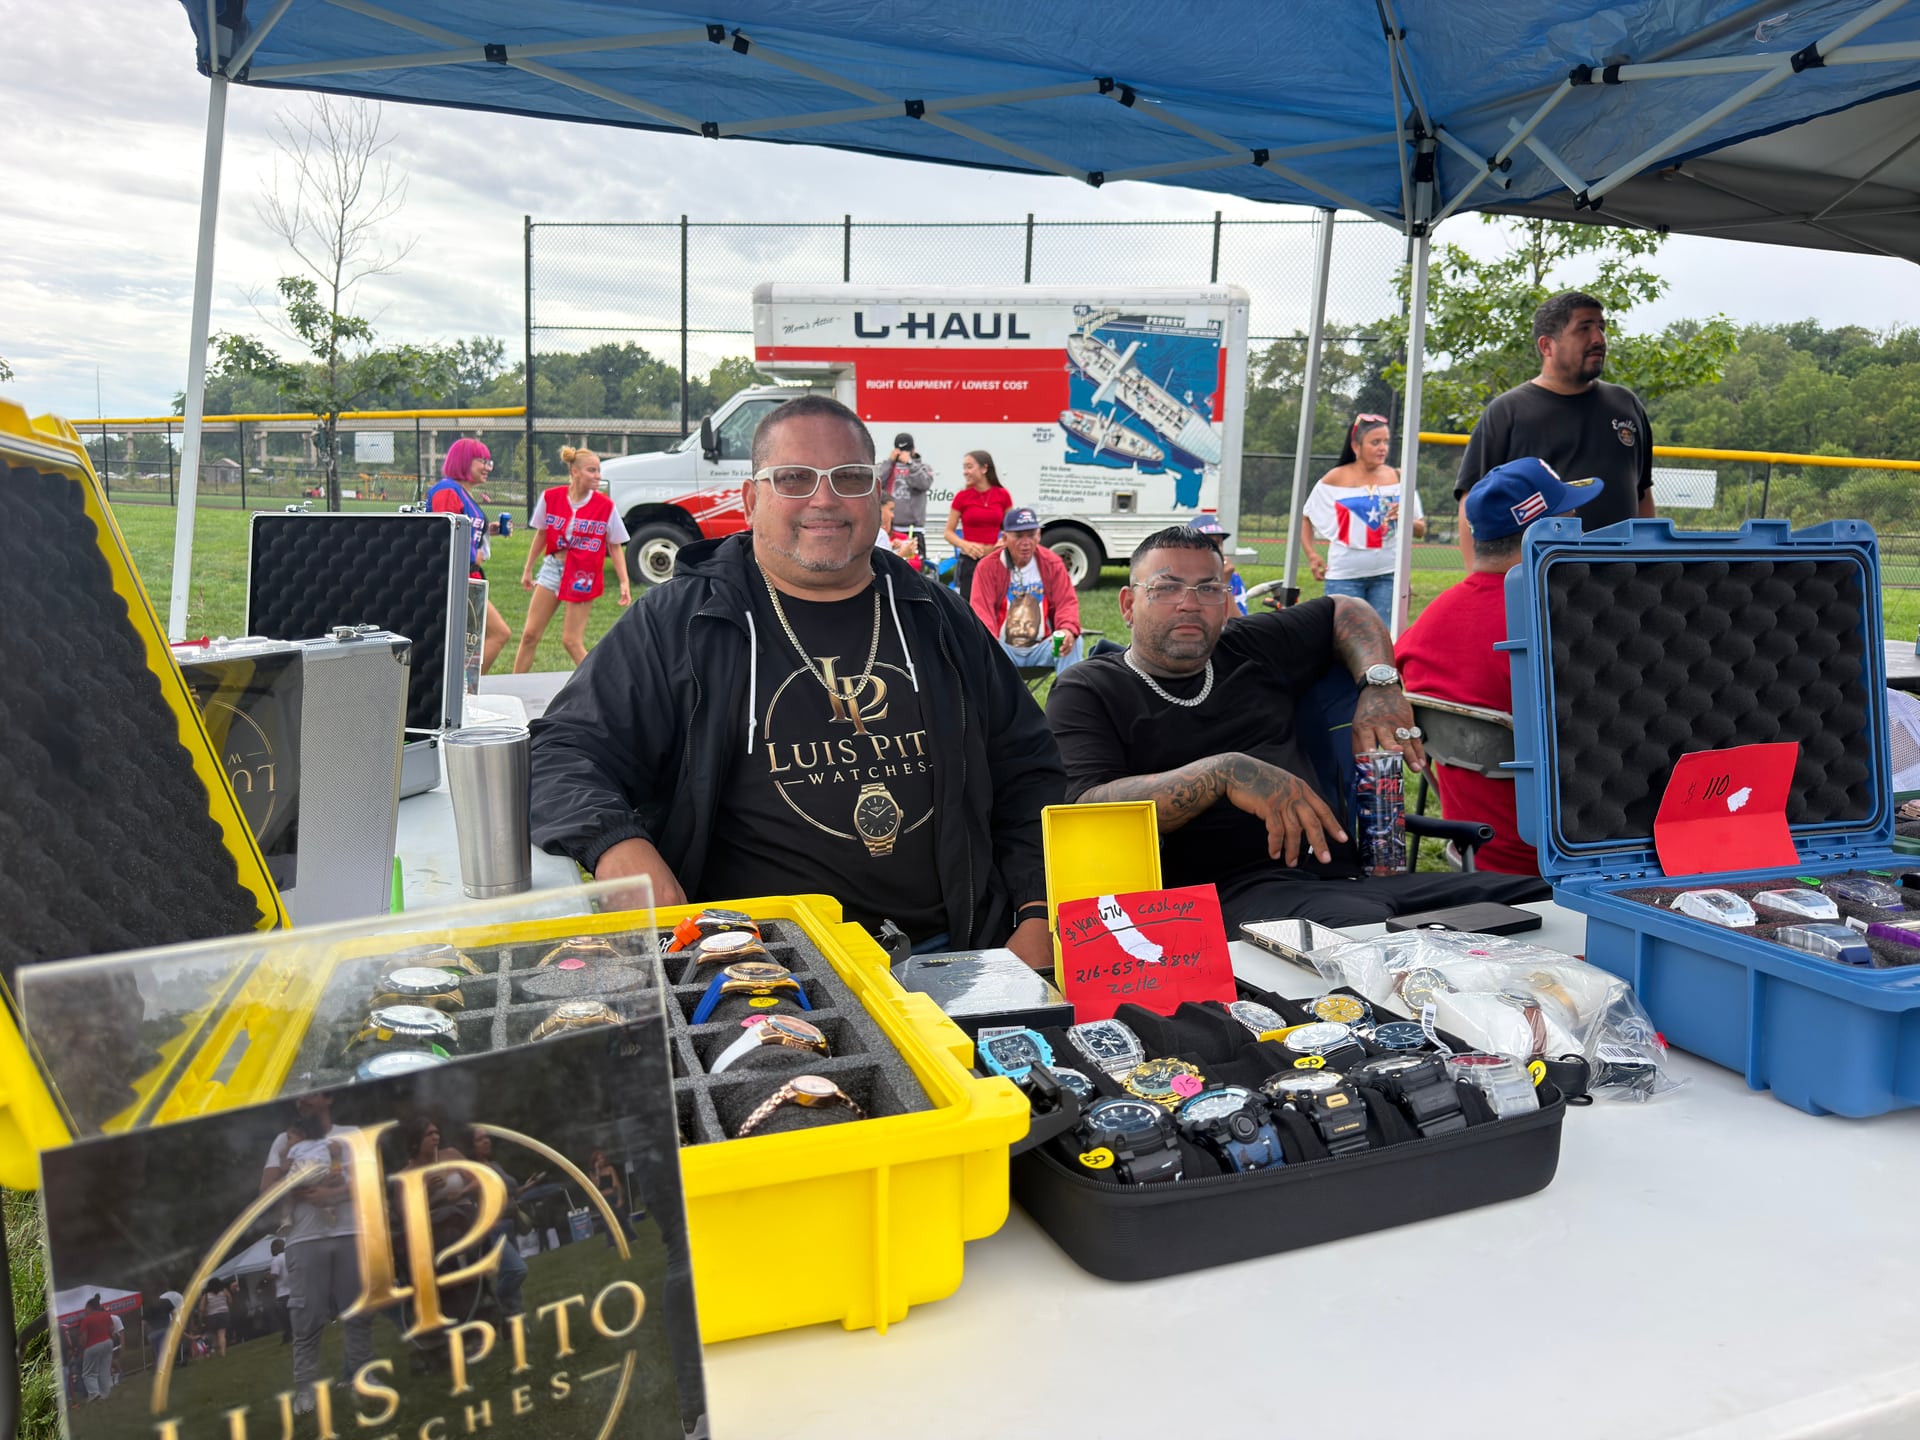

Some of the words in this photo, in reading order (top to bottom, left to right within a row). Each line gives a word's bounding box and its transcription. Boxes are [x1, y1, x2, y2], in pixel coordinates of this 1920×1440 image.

[854, 312, 1030, 340] U-HAUL
[1146, 316, 1220, 330] PENNSYIA
[866, 380, 894, 390] RIGHT
[897, 380, 952, 390] EQUIPMENT
[962, 380, 1000, 390] LOWEST
[1003, 380, 1029, 390] COST
[572, 570, 596, 593] 21
[765, 739, 858, 773] LUIS
[868, 730, 927, 761] PIT
[808, 761, 927, 785] WATCHES
[445, 1281, 645, 1395] PITO
